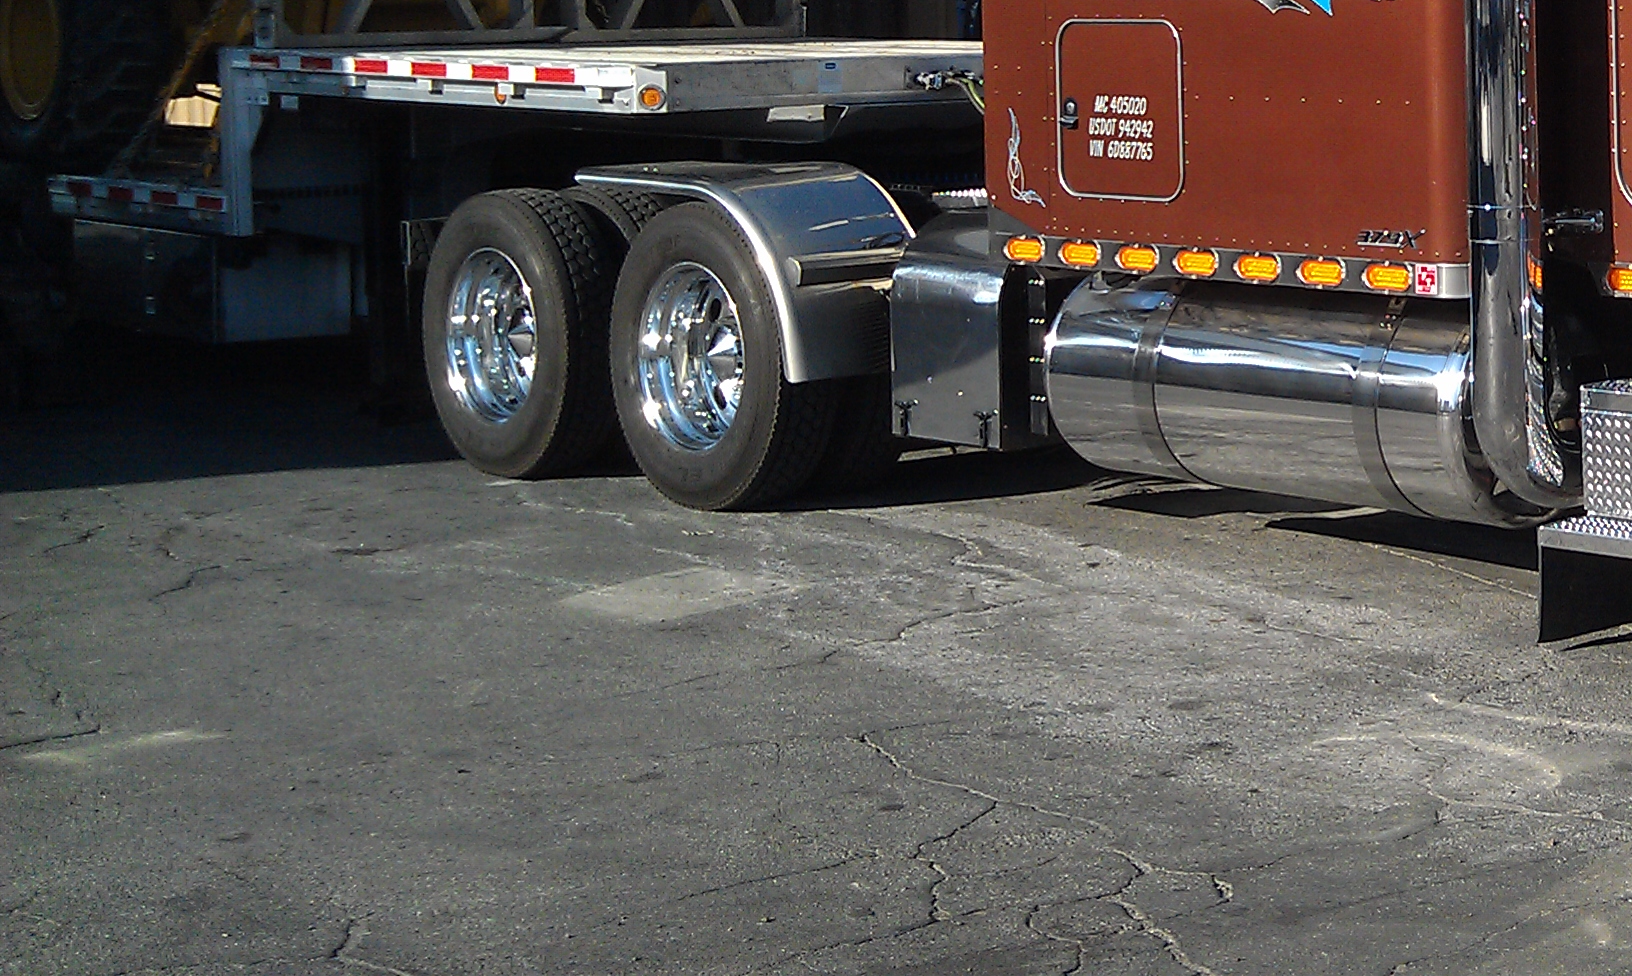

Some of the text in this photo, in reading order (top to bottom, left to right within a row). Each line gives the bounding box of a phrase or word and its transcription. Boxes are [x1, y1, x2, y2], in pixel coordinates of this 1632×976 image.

[1093, 95, 1147, 116] MC 405020
[1088, 117, 1154, 139] USDOT 942942
[1089, 139, 1105, 157] VIN
